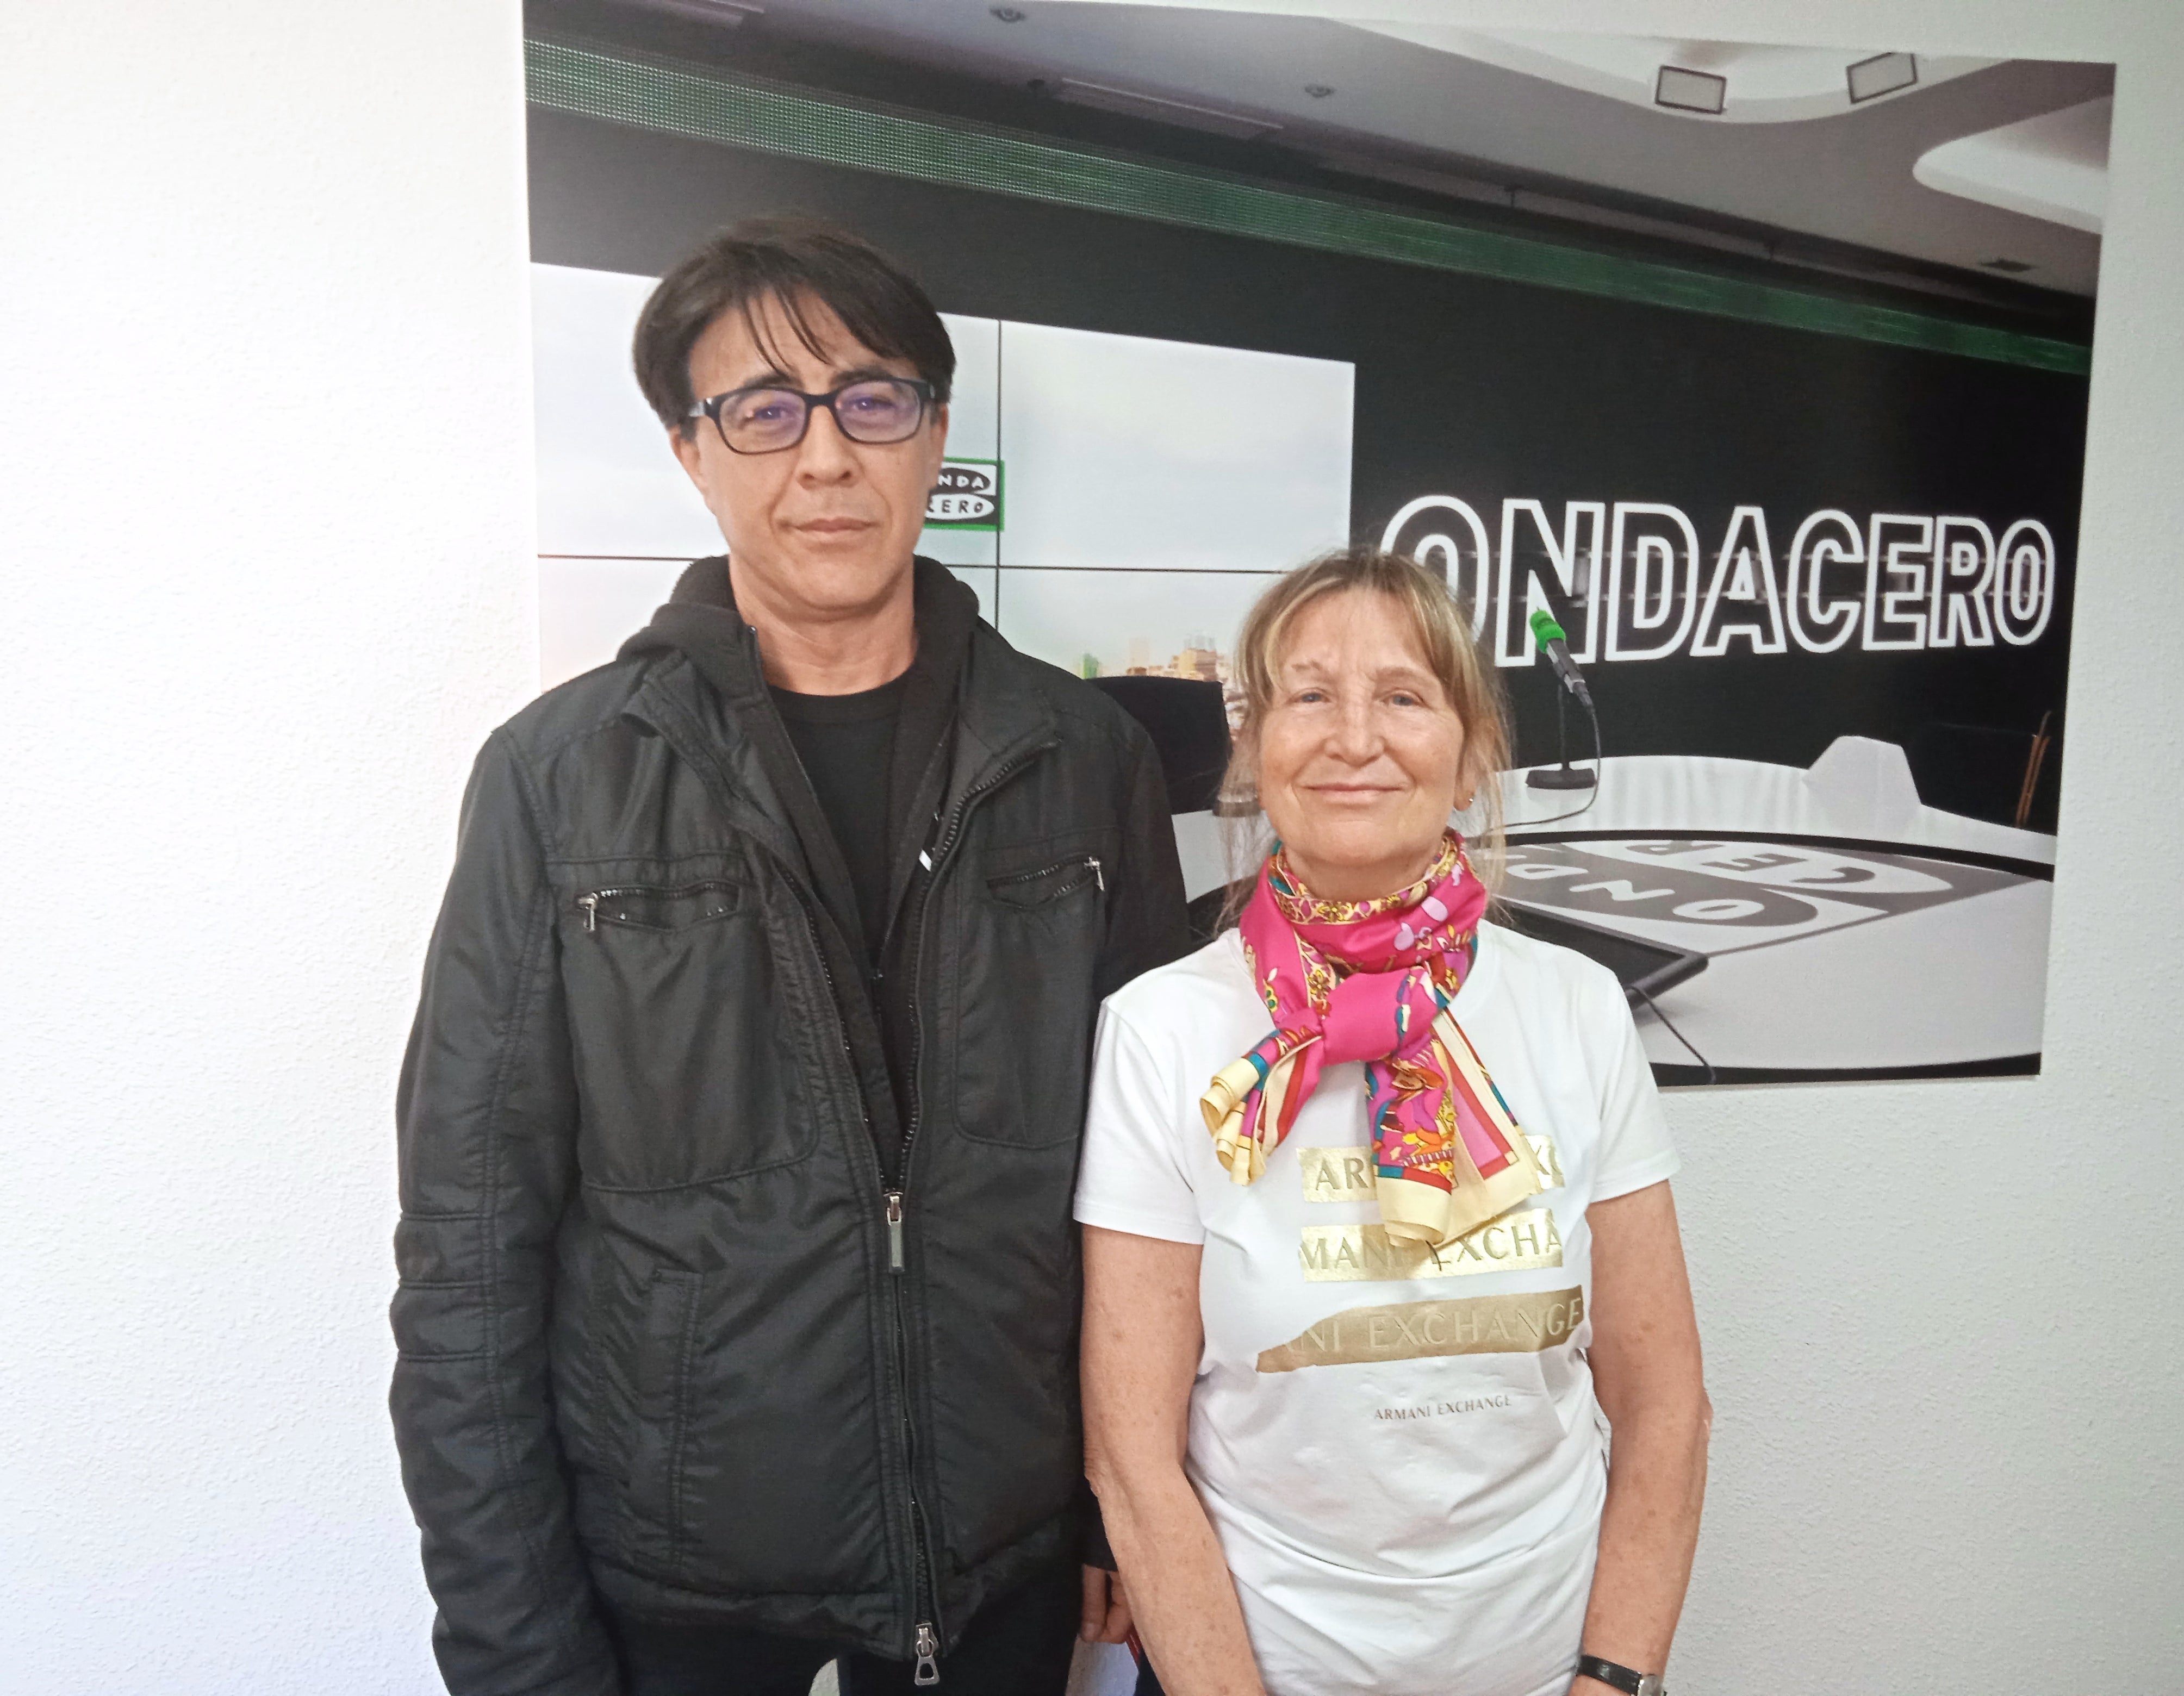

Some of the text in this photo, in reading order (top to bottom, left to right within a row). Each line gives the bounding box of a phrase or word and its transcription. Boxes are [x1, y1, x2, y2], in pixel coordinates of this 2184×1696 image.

[938, 475, 984, 489] NDA
[1380, 495, 2056, 668] ONDACERO
[1625, 840, 1876, 884] CER
[1315, 1157, 1369, 1191] AR
[1286, 1297, 1582, 1354] NI EXCHANGE
[1374, 1395, 1511, 1419] ARMANI EXCHANGE
